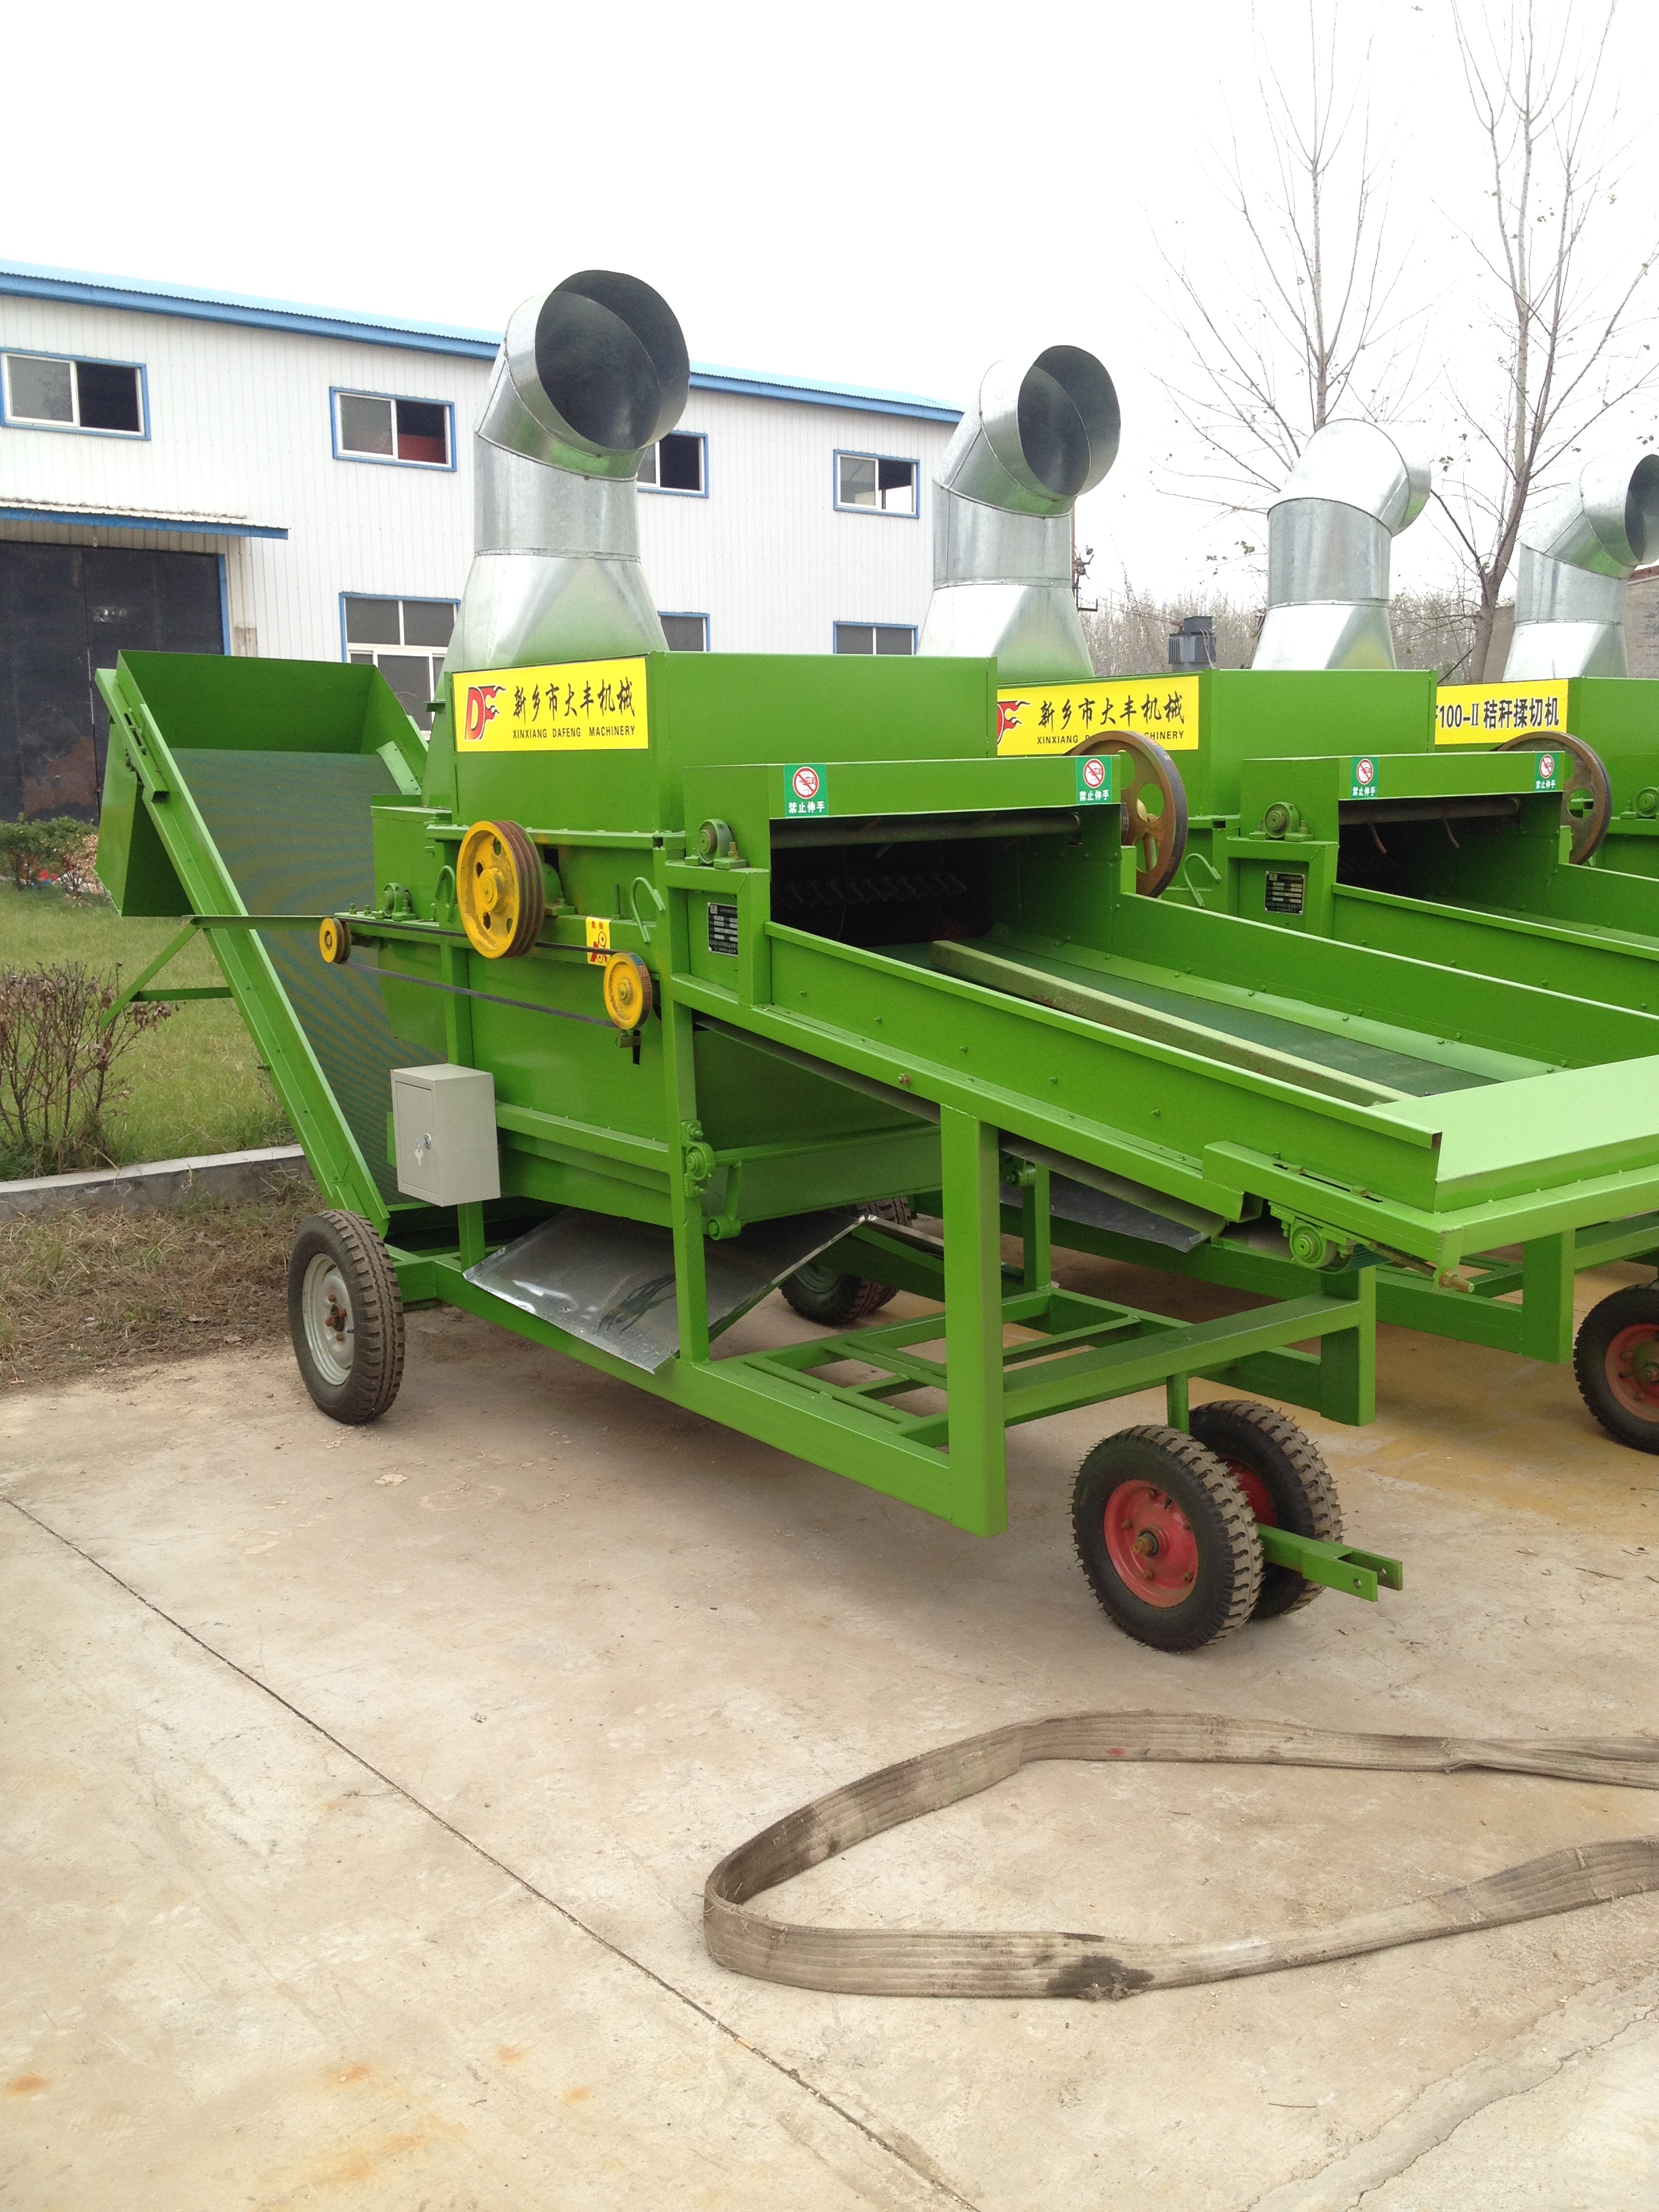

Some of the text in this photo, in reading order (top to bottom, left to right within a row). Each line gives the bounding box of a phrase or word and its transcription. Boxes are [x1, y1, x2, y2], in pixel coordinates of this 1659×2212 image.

[512, 676, 636, 725] 新乡市大丰机械
[1038, 691, 1185, 732] 新乡市大丰机械
[1435, 696, 1560, 730] 100-II 秸秆揉切机
[512, 725, 636, 739] XINXIANG DAFENG MACHINERY
[1037, 735, 1078, 745] XINXIANG
[1079, 789, 1109, 802] 禁止伸手
[1352, 786, 1376, 797] 禁止伸手
[788, 800, 825, 814] 禁止伸手
